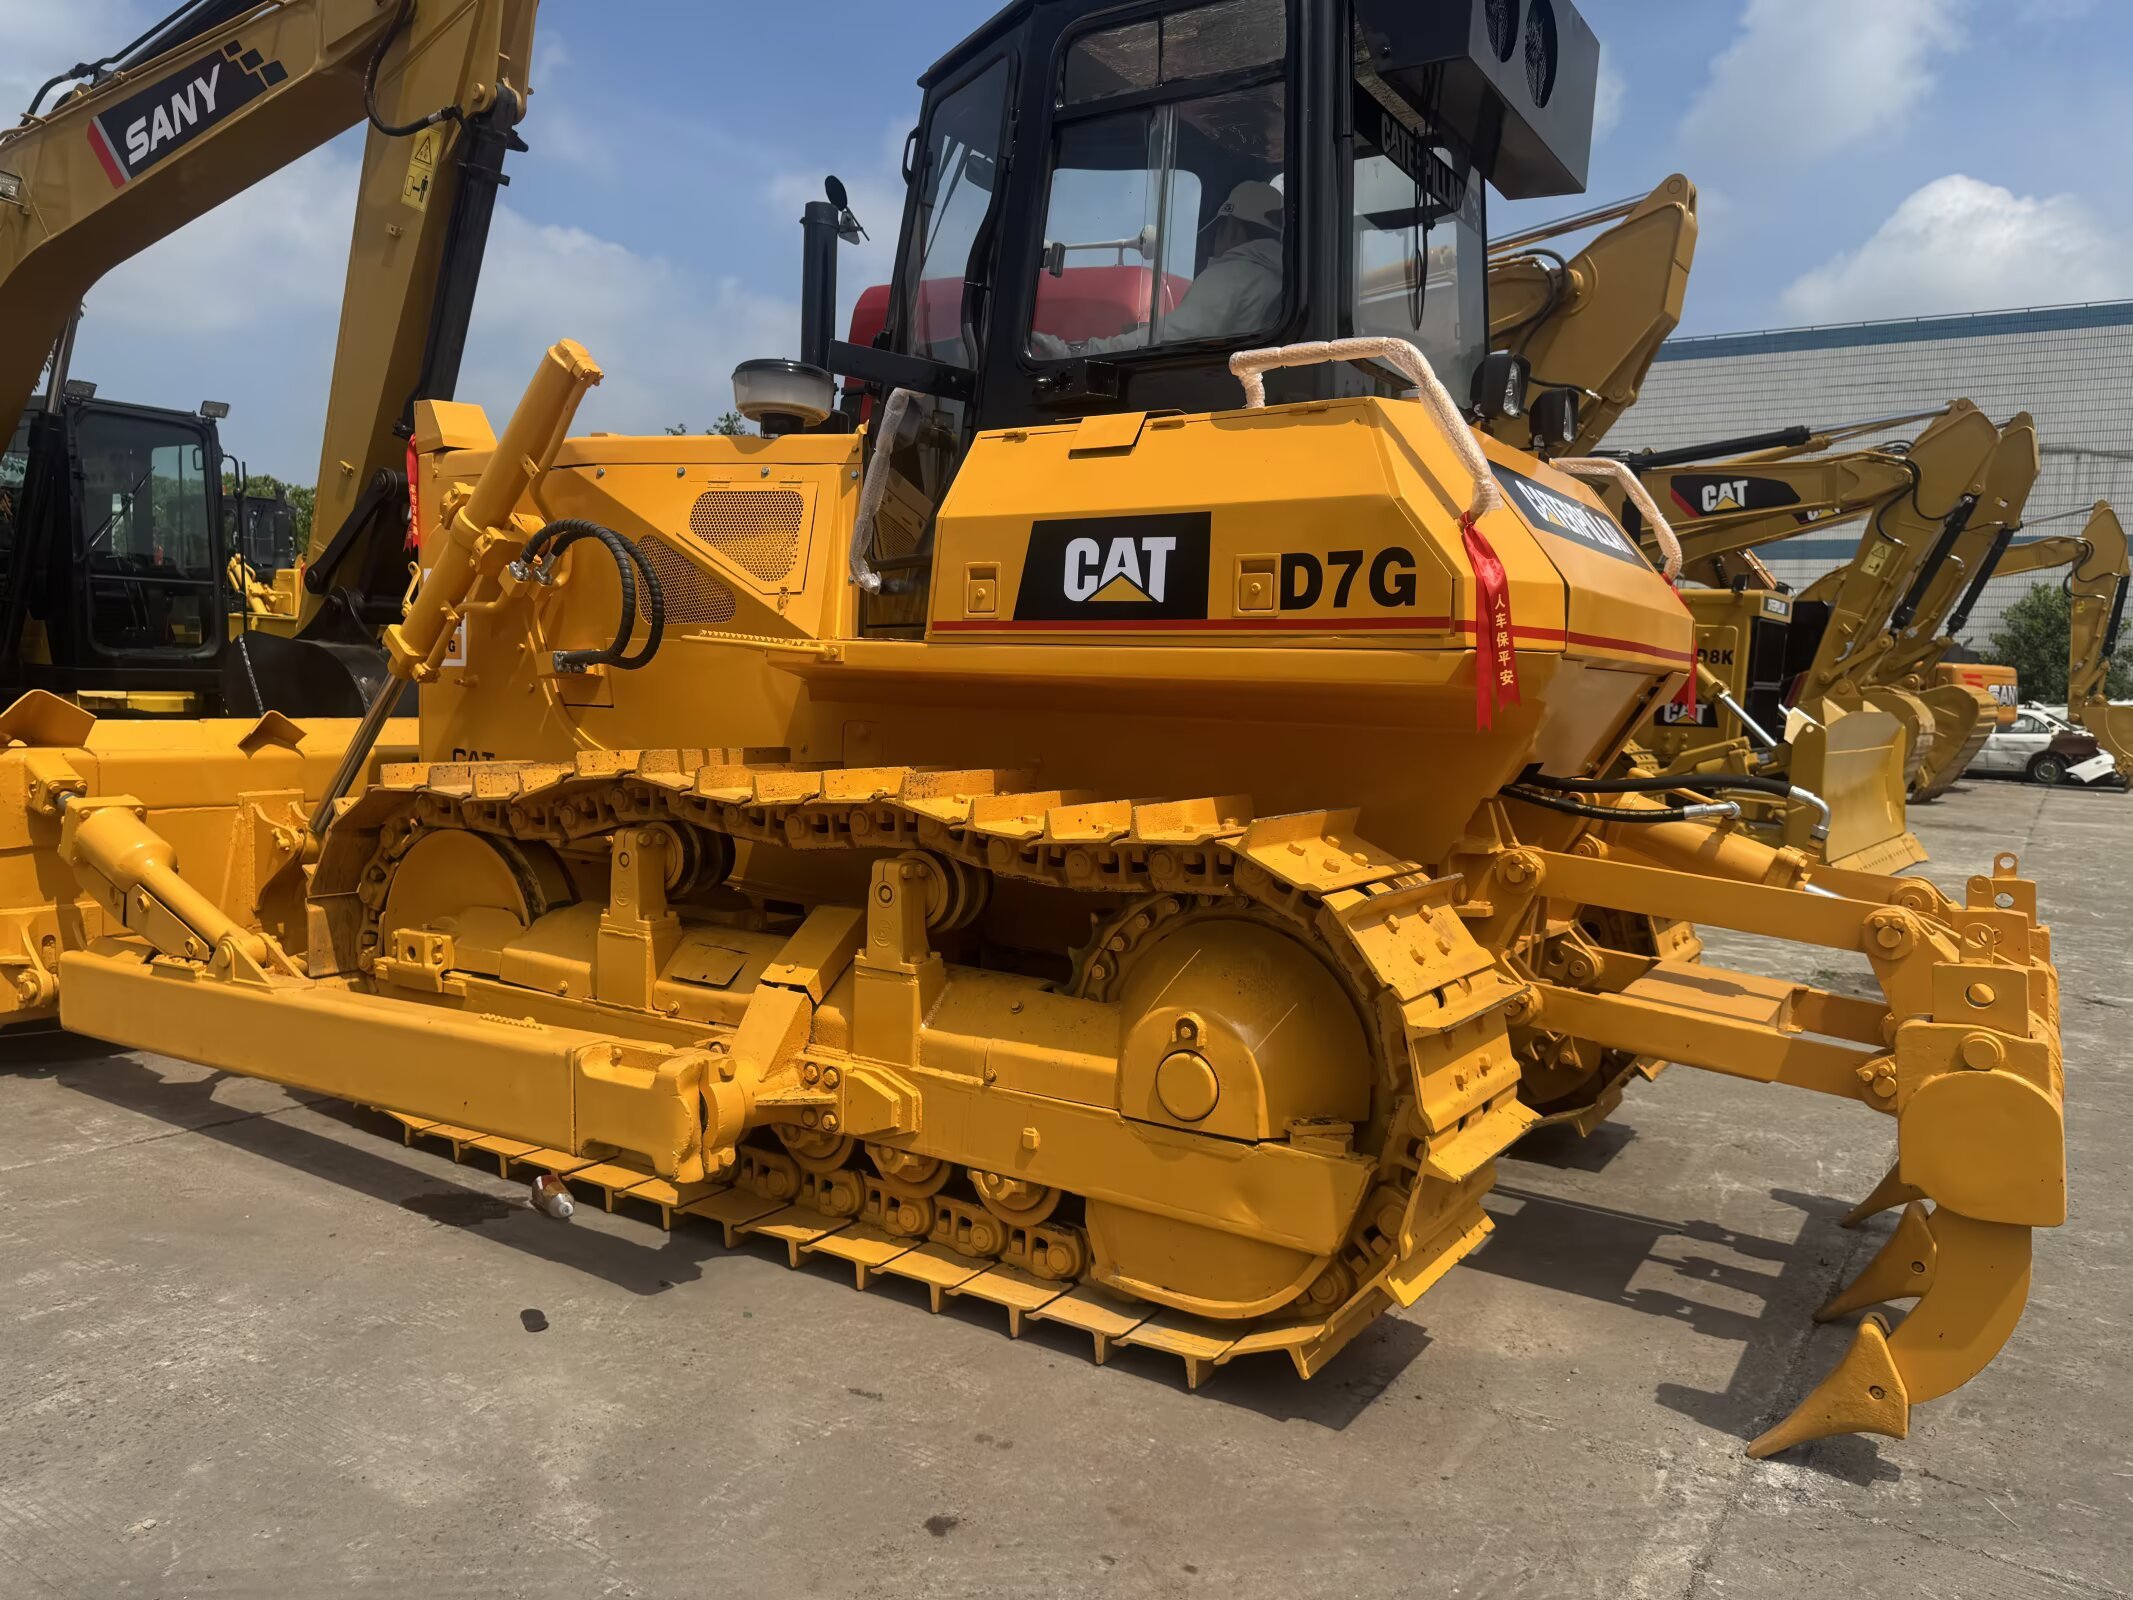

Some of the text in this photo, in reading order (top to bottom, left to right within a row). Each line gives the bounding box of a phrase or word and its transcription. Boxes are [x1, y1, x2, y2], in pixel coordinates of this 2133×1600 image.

[126, 63, 220, 166] SANY
[1515, 480, 1635, 557] CATERPILLAR
[1702, 480, 1748, 512] CAT
[1064, 536, 1177, 603] CAT
[1279, 546, 1417, 610] D7G
[1494, 593, 1515, 686] 人车保平安
[1697, 648, 1735, 665] D8K
